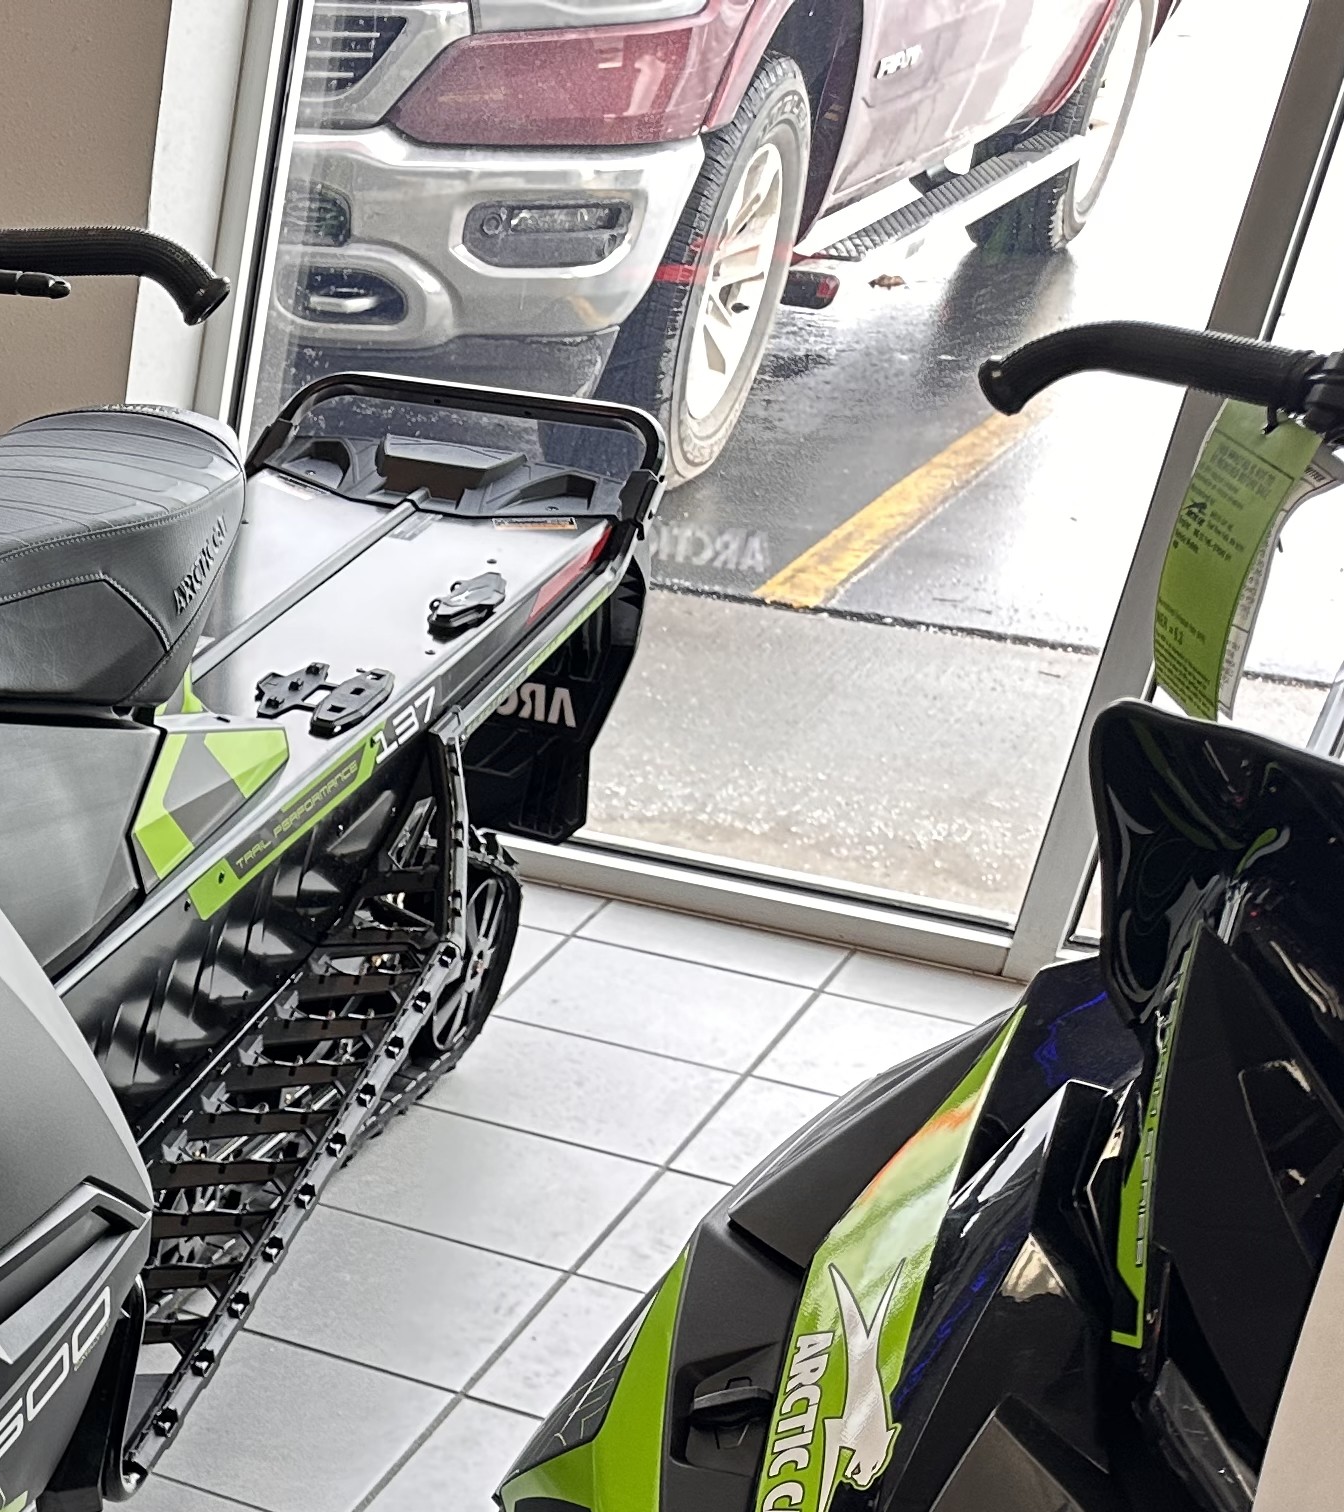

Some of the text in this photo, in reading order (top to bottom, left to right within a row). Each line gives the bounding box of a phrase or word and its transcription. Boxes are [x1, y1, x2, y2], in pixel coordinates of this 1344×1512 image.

[874, 44, 922, 79] RAM
[173, 537, 215, 616] ARCTIC
[375, 686, 436, 764] 137
[236, 759, 358, 869] TRAIL PERFORMANCE
[767, 1331, 835, 1478] ARCTIC
